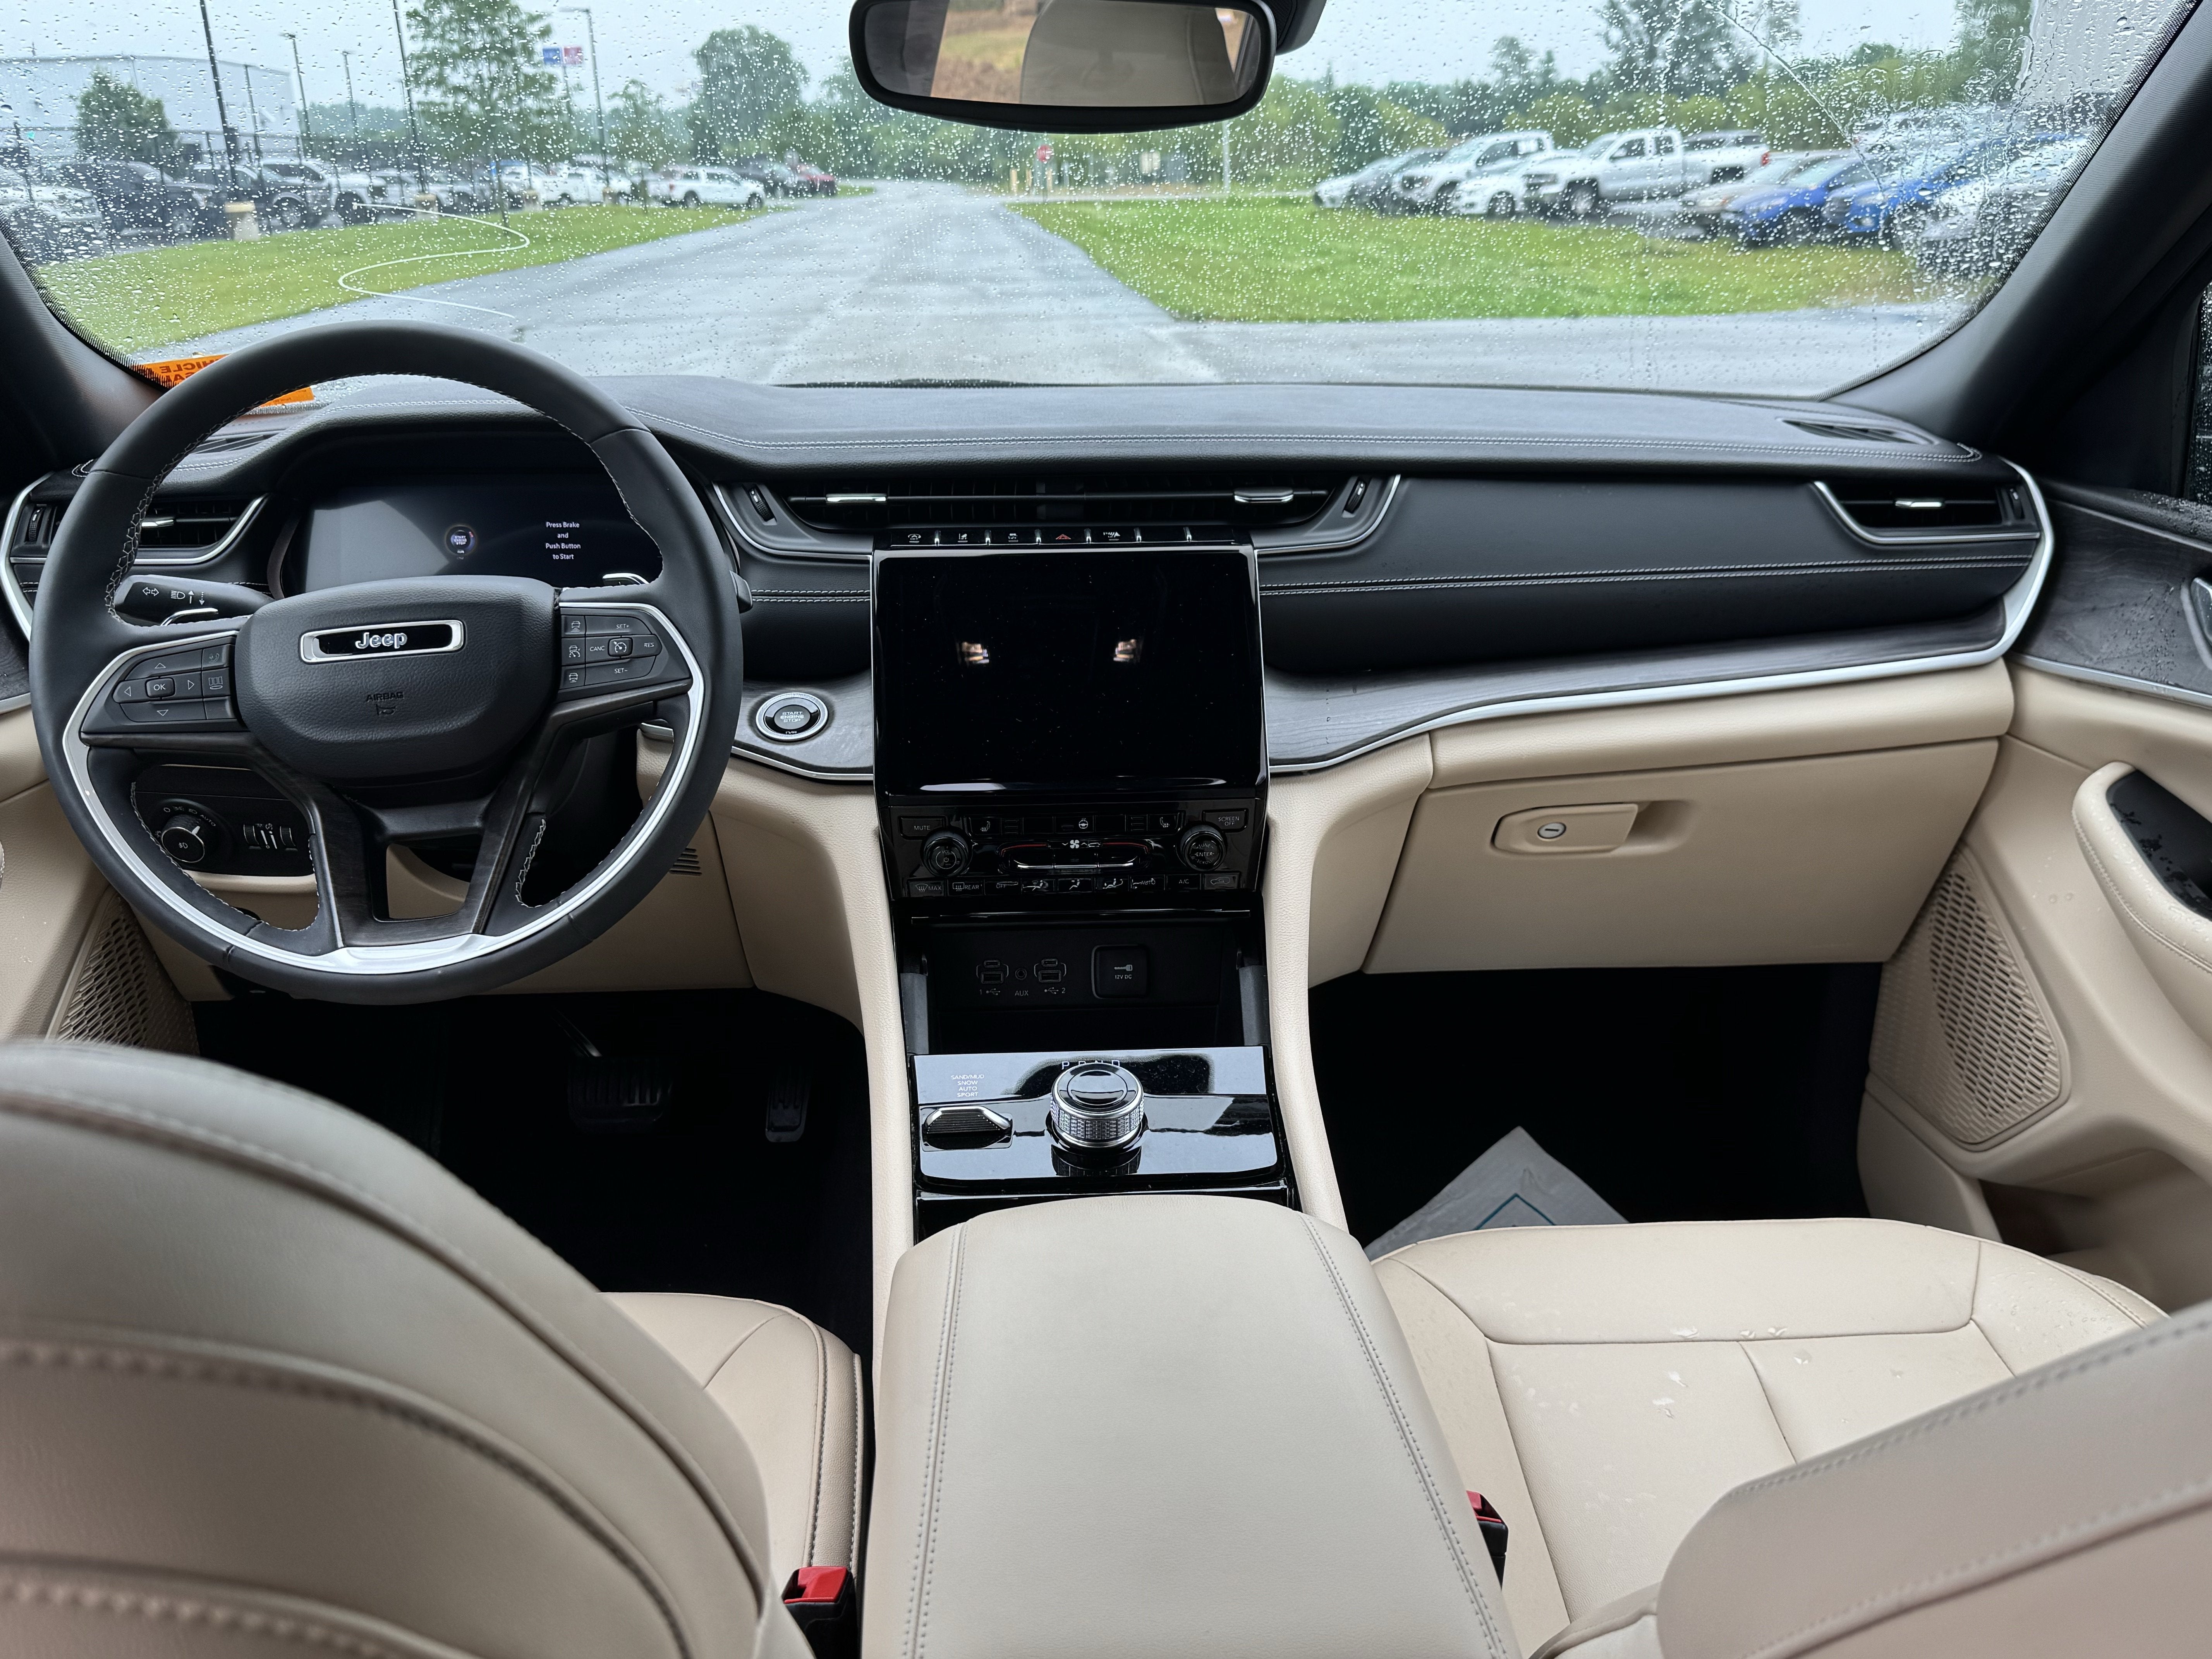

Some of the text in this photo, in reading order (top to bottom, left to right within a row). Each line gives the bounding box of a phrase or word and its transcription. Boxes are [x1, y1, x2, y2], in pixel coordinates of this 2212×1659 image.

[355, 632, 407, 649] Jeep
[366, 692, 404, 701] AIRBAG
[200, 814, 216, 826] AUTO
[1061, 1061, 1070, 1070] P
